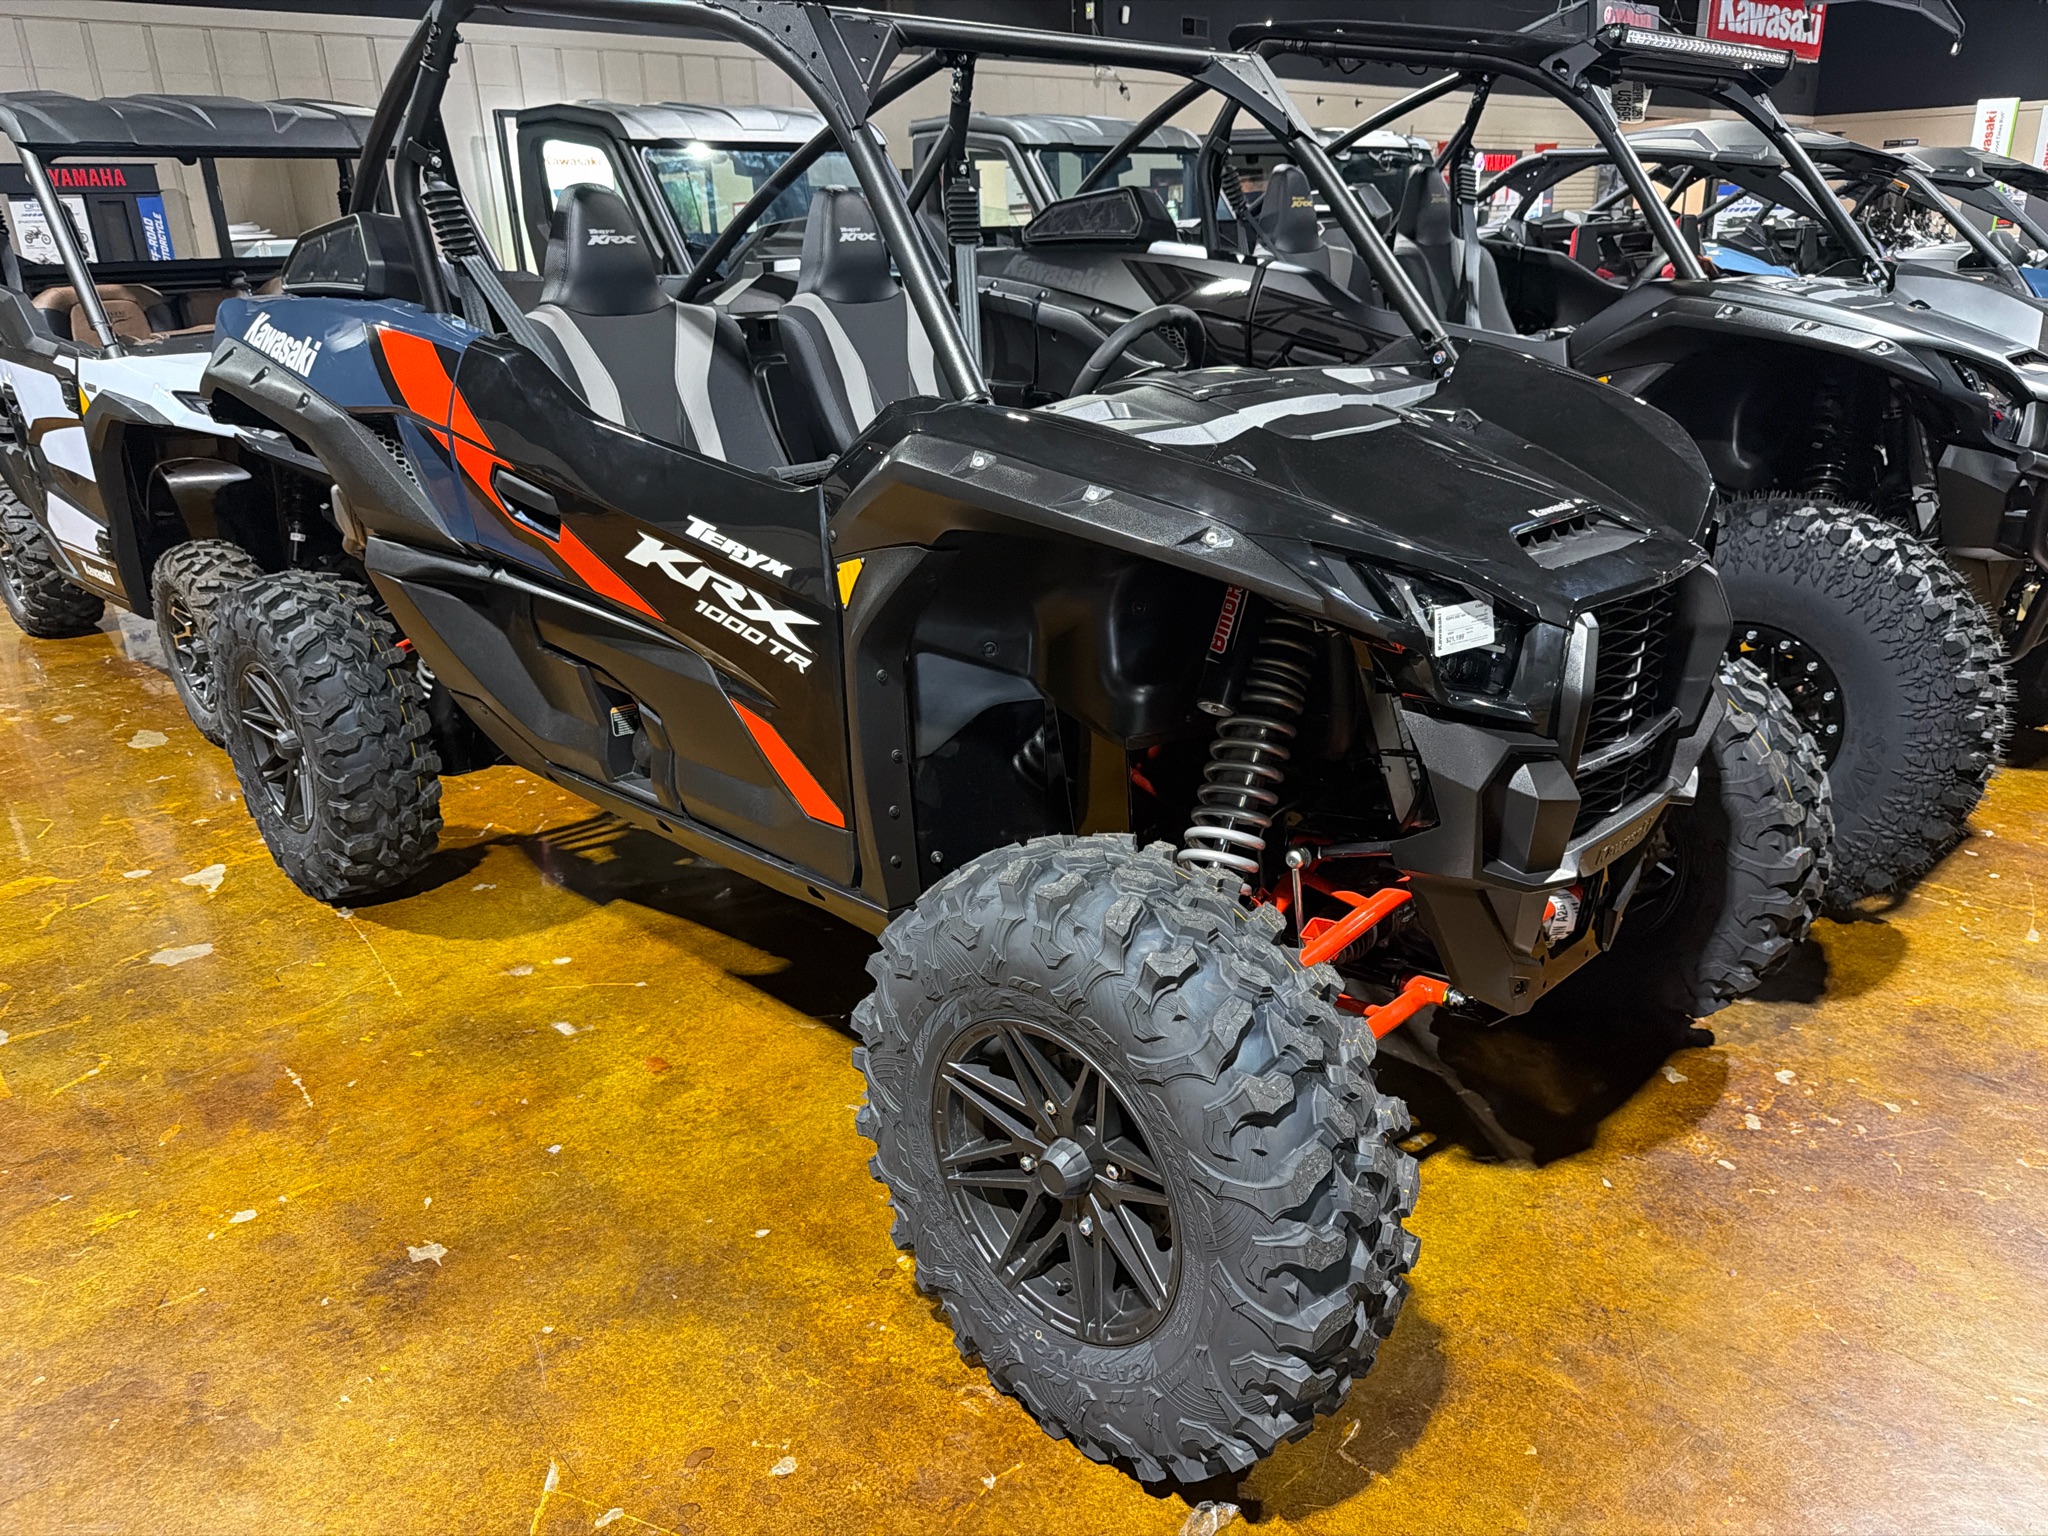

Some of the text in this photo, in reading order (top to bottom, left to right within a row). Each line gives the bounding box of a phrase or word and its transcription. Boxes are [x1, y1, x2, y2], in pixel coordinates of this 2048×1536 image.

[1718, 0, 1822, 45] Kawasaki
[47, 168, 127, 187] YAMAHA
[1485, 154, 1516, 171] YAMAHA
[143, 216, 160, 261] FF-ROAD
[152, 212, 172, 261] TORCYCLE
[587, 235, 637, 246] KRX
[839, 232, 877, 243] KRX
[243, 311, 323, 378] Kawasaki
[1528, 499, 1575, 517] Kawasaki
[81, 559, 116, 587] Kawasaki
[624, 529, 821, 654] KRX
[695, 599, 813, 674] 1000 TR
